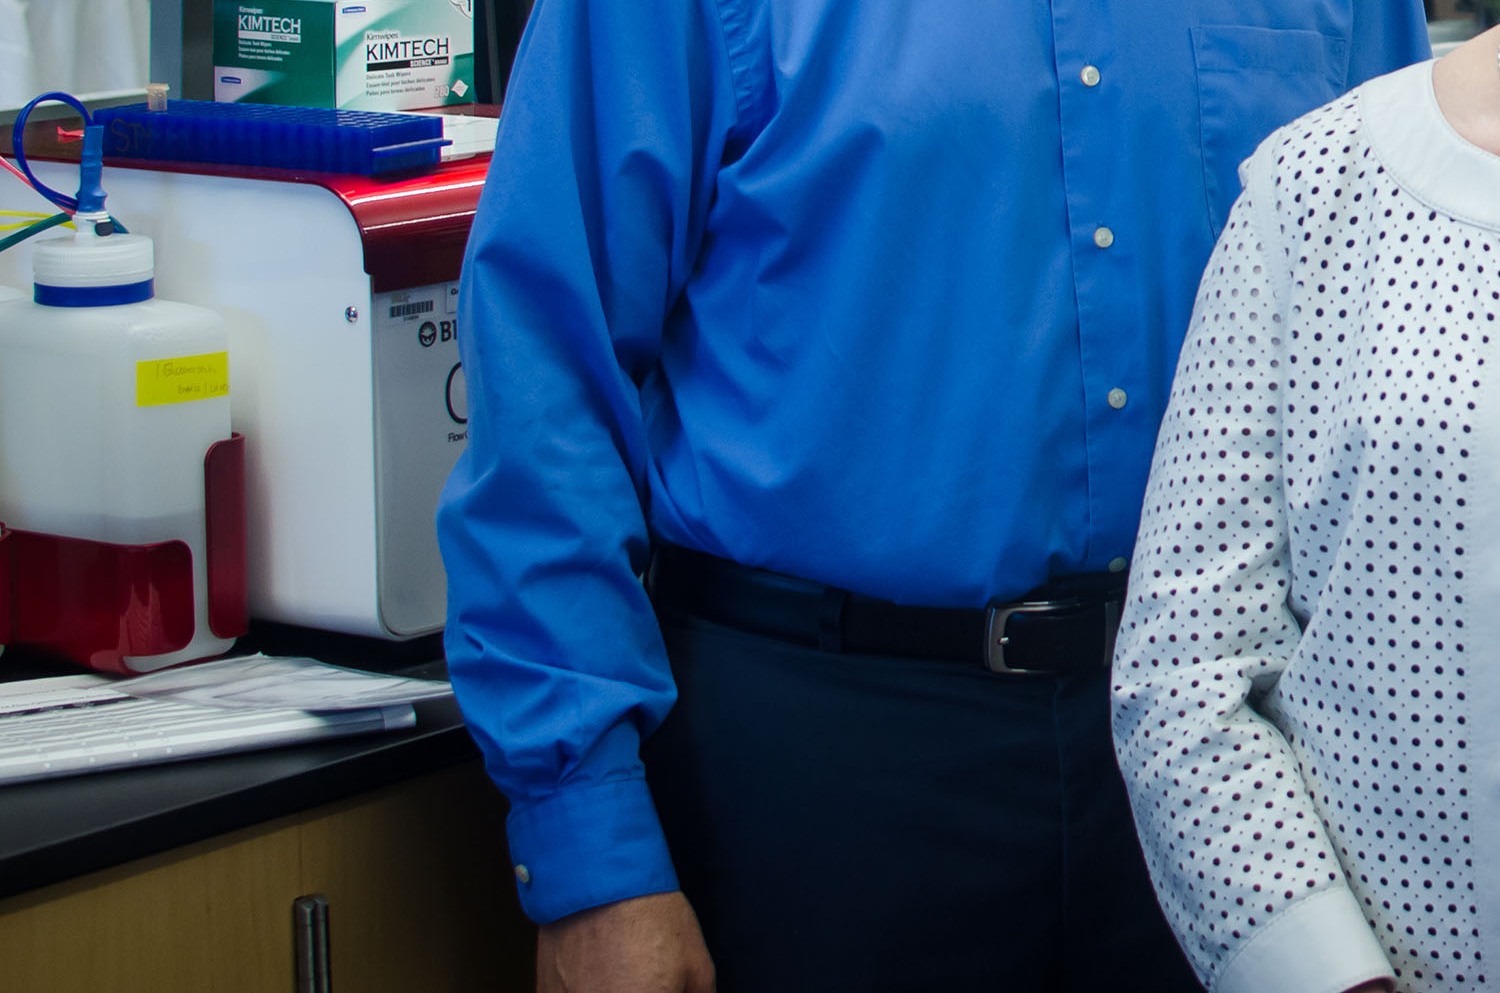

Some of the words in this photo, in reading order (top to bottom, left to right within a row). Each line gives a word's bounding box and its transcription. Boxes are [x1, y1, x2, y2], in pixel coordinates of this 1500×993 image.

[238, 14, 301, 34] KIMTECH
[366, 32, 399, 43] Kimwipes
[366, 37, 449, 62] KIMTECH
